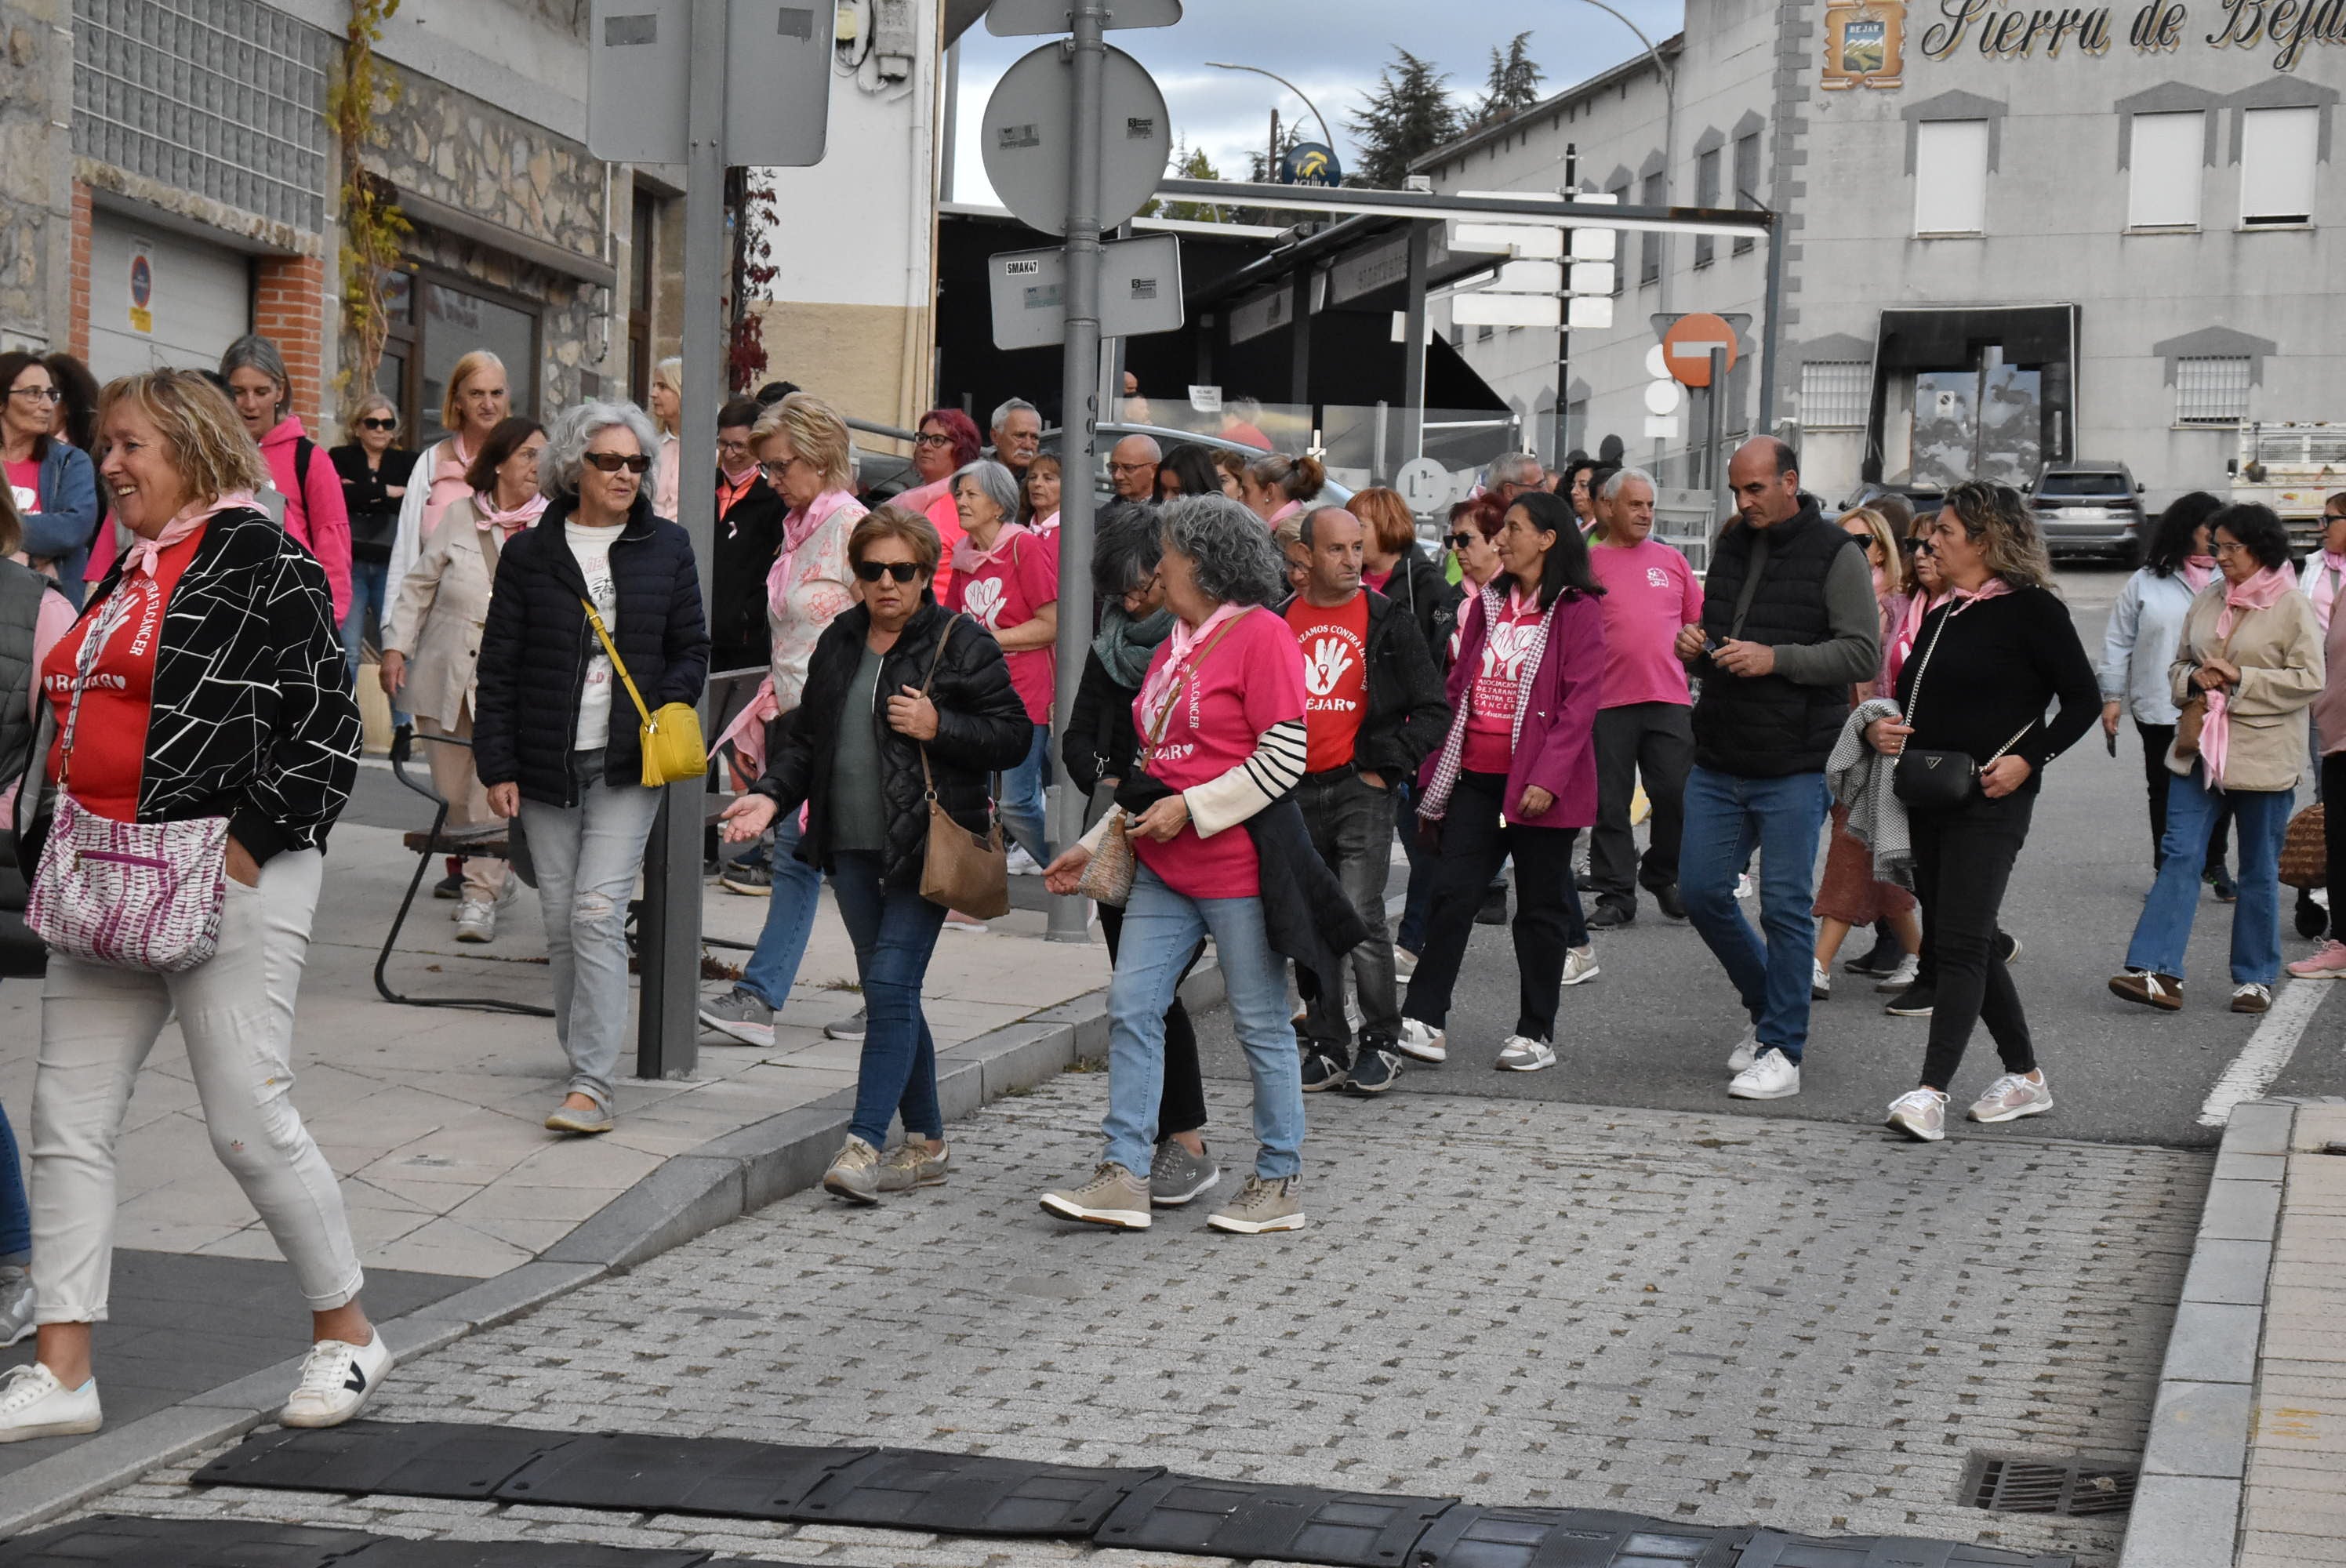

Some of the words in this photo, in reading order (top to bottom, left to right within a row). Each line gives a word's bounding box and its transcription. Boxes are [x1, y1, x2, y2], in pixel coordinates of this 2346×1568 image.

[2130, 0, 2189, 53] de
[2205, 0, 2346, 71] Beja
[1007, 261, 1037, 274] SMAK47
[1330, 625, 1362, 648] CONTRA
[1306, 695, 1346, 711] ÉJAR
